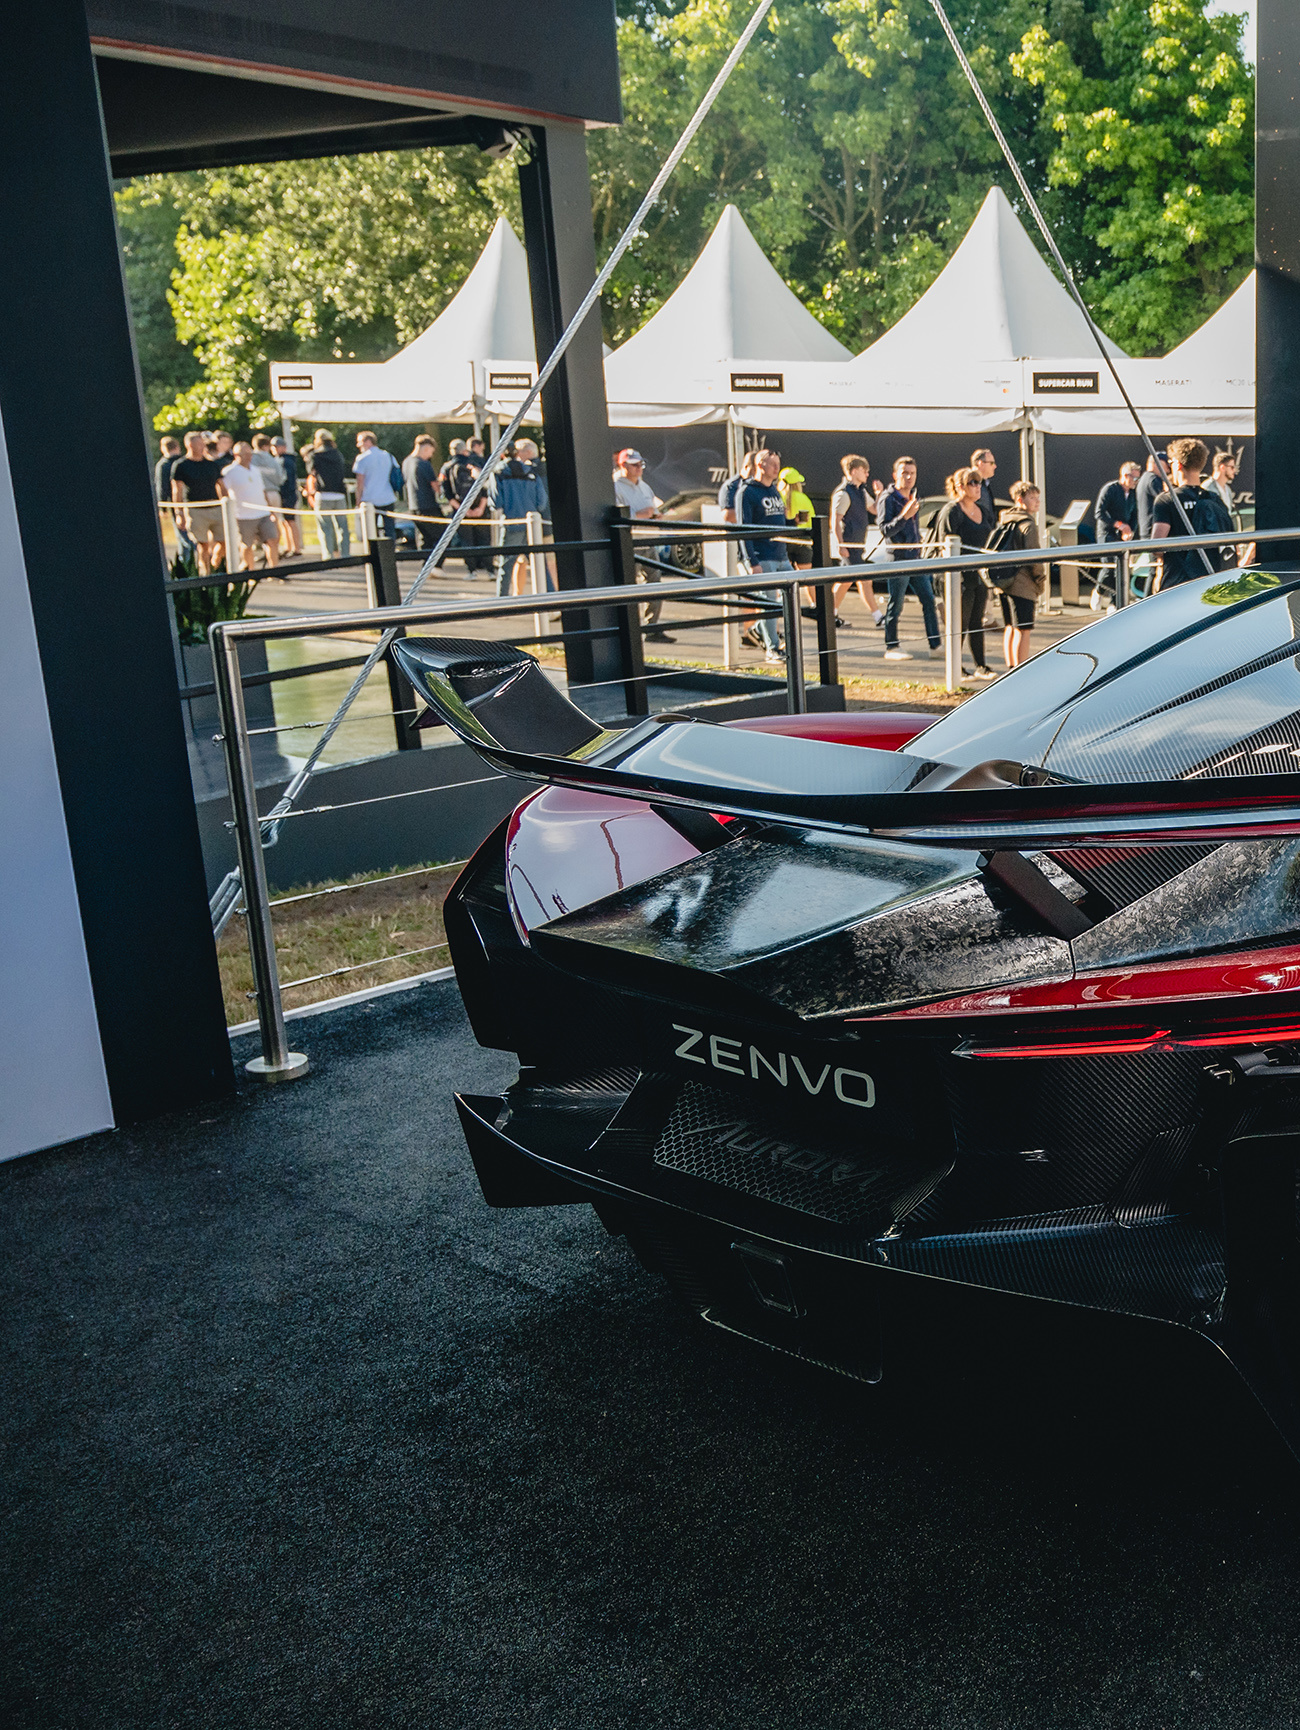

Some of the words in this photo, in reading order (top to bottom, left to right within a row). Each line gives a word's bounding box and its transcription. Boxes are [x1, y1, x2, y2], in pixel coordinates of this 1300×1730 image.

[1038, 378, 1076, 388] SUPERCAR
[1076, 378, 1093, 388] RUN
[672, 1023, 876, 1108] ZENVO
[683, 1119, 888, 1192] AURORA
